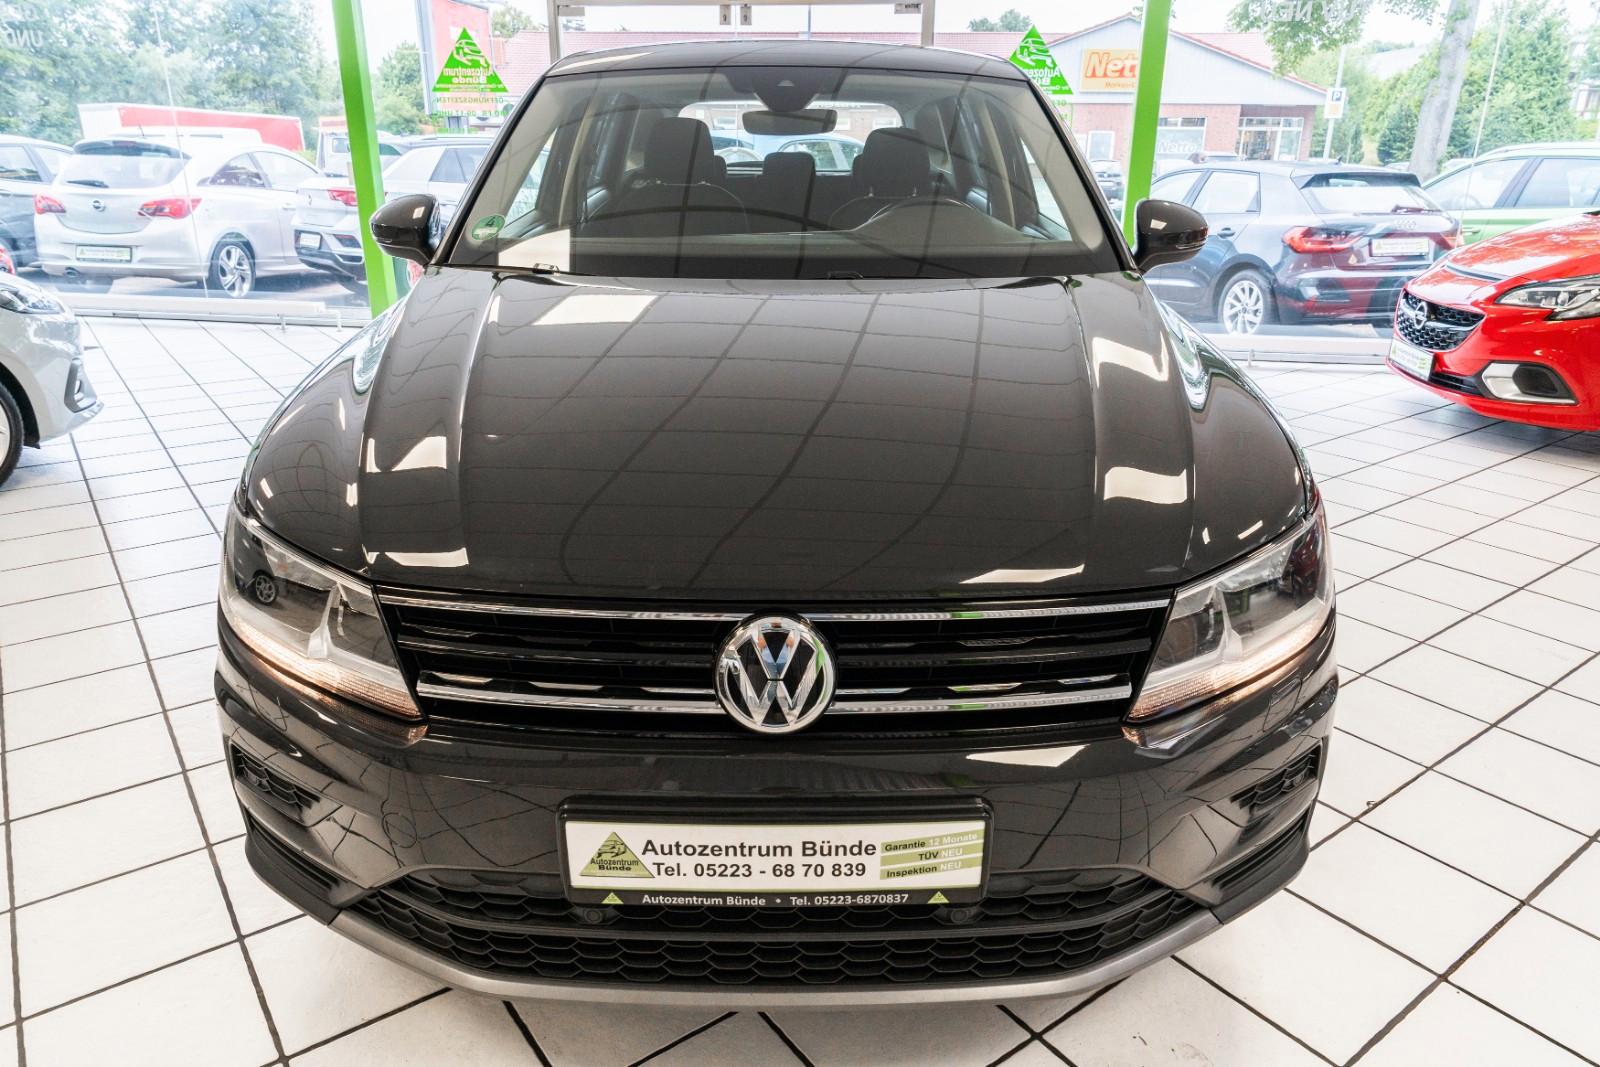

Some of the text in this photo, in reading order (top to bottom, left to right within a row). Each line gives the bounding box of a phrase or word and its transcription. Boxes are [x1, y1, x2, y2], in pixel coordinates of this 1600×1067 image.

[1158, 141, 1197, 154] Netto
[484, 216, 496, 227] 4
[642, 839, 878, 858] Autozentrum Bünde
[884, 833, 978, 852] Garantie 12 Monate
[918, 847, 963, 861] TÜV NEU
[590, 858, 639, 866] Autozentrum
[652, 862, 687, 877] Tel.
[694, 863, 752, 878] 05223
[772, 864, 795, 878] 68
[802, 863, 825, 878] 70
[831, 862, 866, 877] 839
[886, 860, 962, 879] Inspektion NEU
[642, 893, 909, 907] Autozentrum Bünde Tel. 05223-6870837
